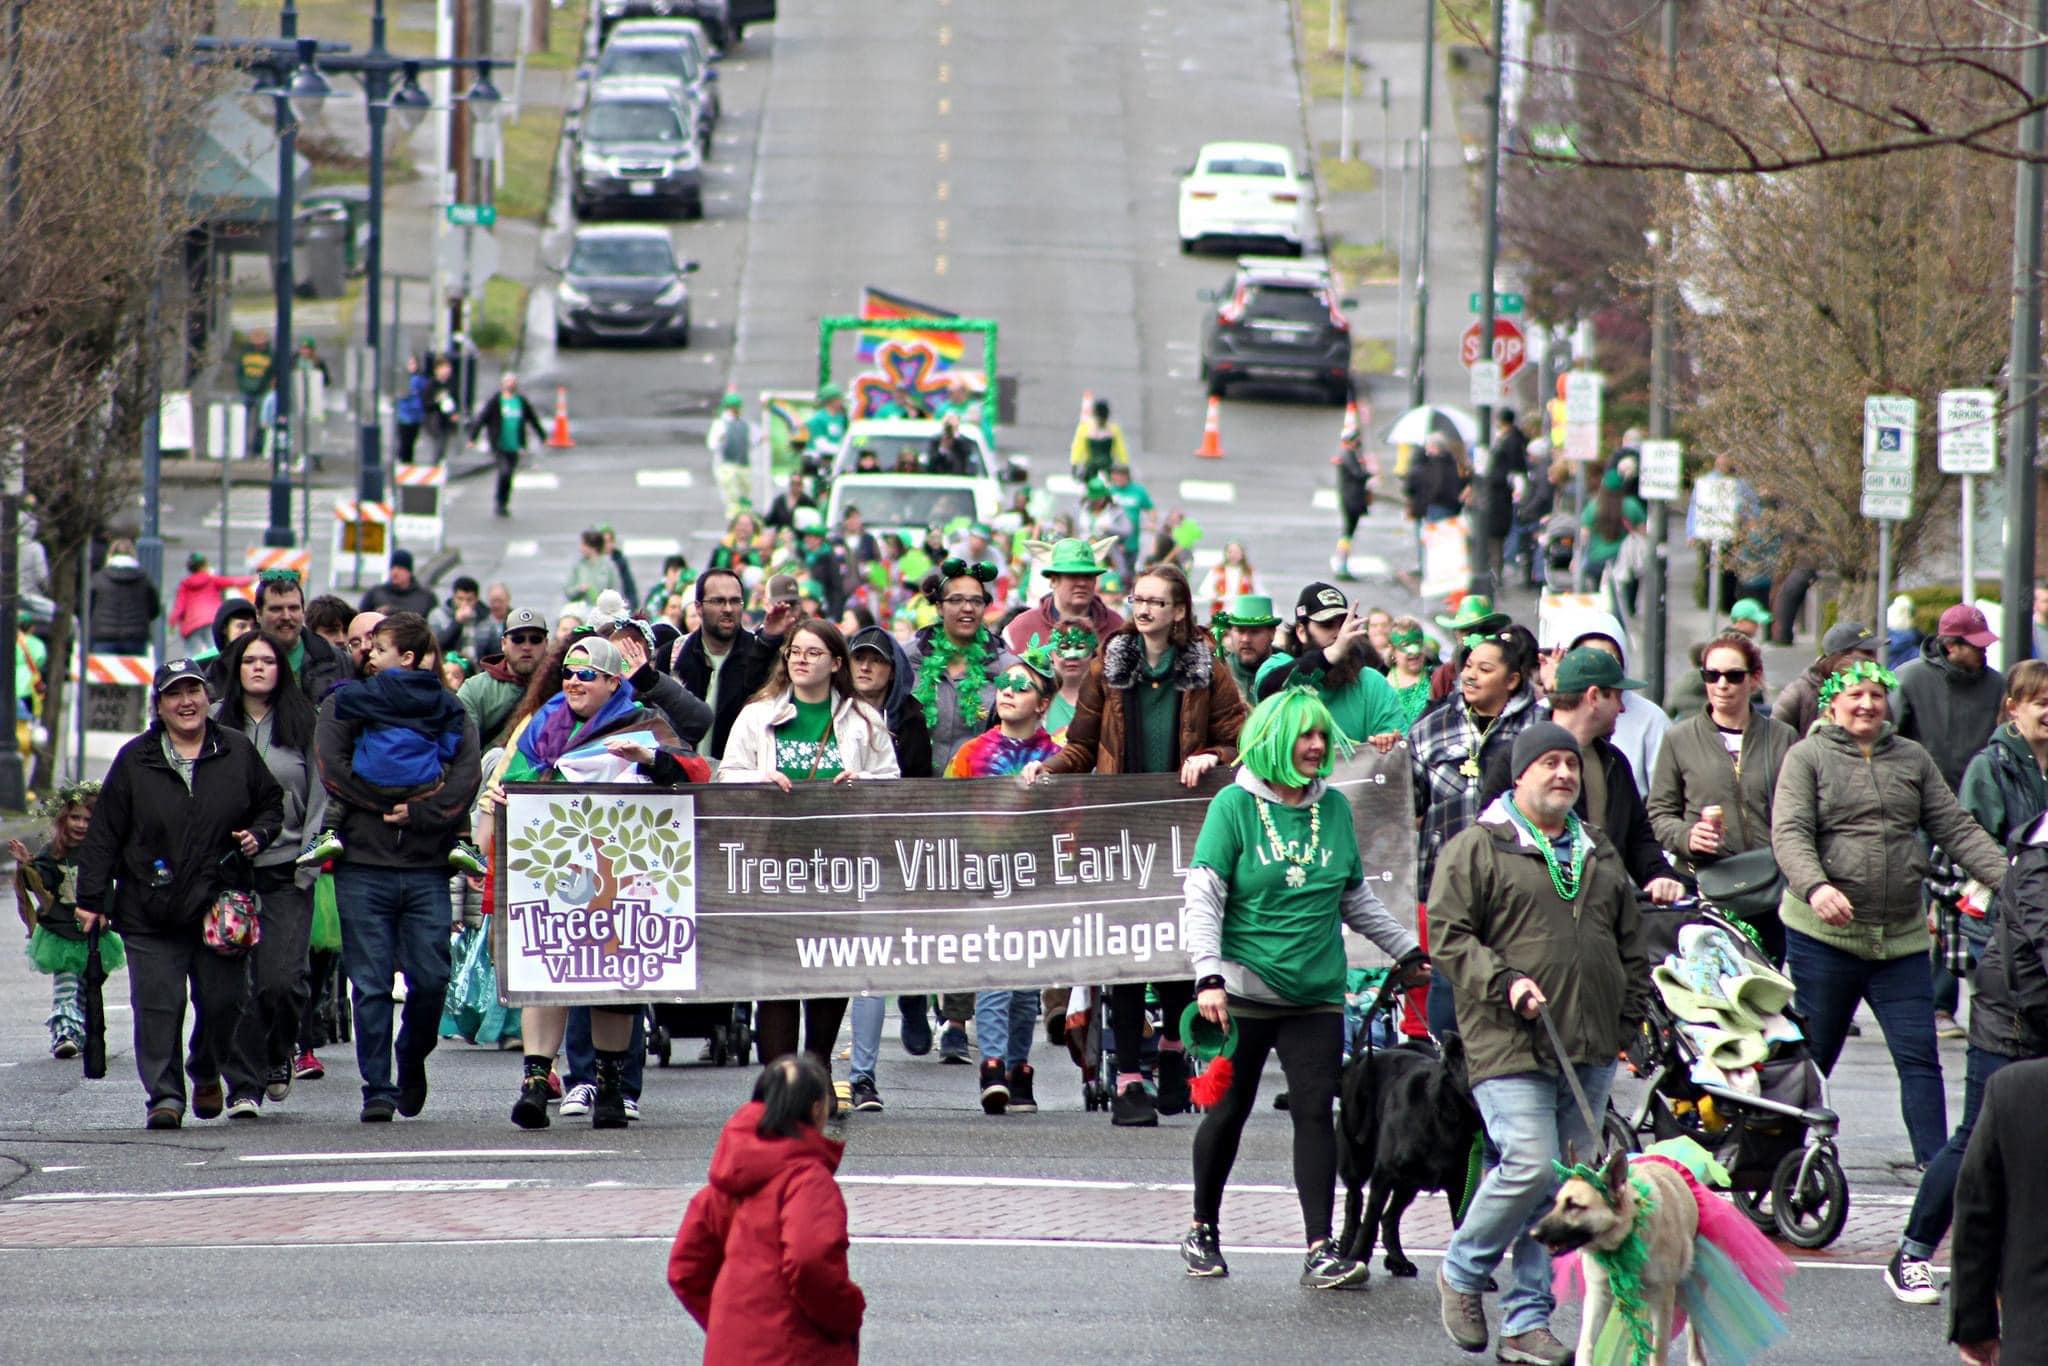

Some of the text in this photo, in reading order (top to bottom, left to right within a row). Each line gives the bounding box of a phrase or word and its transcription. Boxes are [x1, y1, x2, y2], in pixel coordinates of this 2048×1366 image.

[1464, 335, 1522, 362] SOP
[1947, 410, 1985, 420] PARKING
[93, 704, 126, 716] AND
[719, 841, 880, 902] Treetop
[895, 838, 1037, 898] Village
[1052, 829, 1156, 889] Early
[543, 945, 664, 990] village
